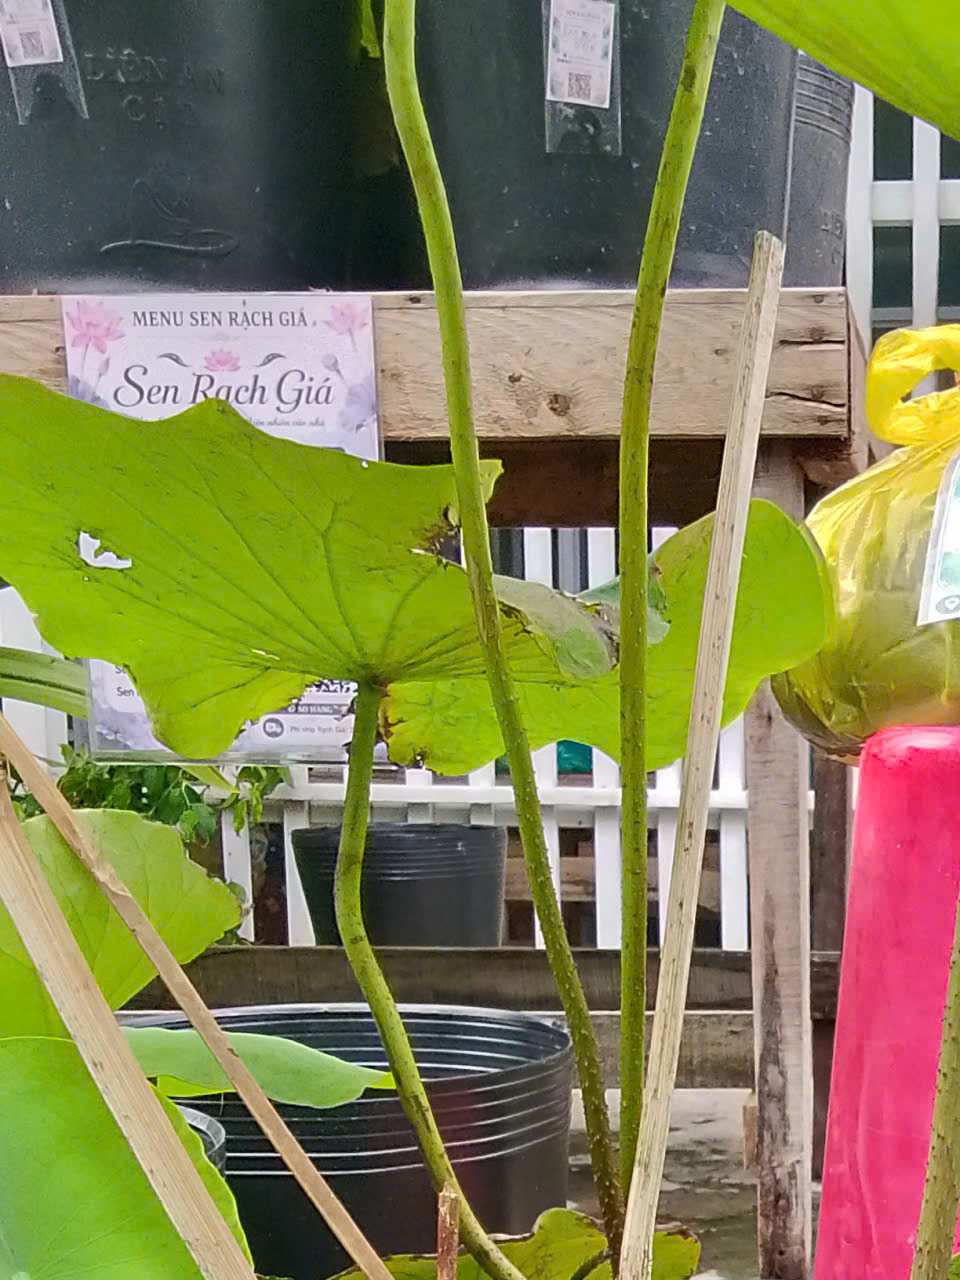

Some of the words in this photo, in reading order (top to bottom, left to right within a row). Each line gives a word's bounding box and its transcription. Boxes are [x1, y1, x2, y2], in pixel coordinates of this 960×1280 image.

[133, 310, 184, 327] MENU
[190, 310, 222, 327] SEN
[229, 310, 274, 331] RẠCH
[113, 364, 180, 408] Sen
[275, 368, 333, 415] Giá
[117, 686, 135, 697] Sen
